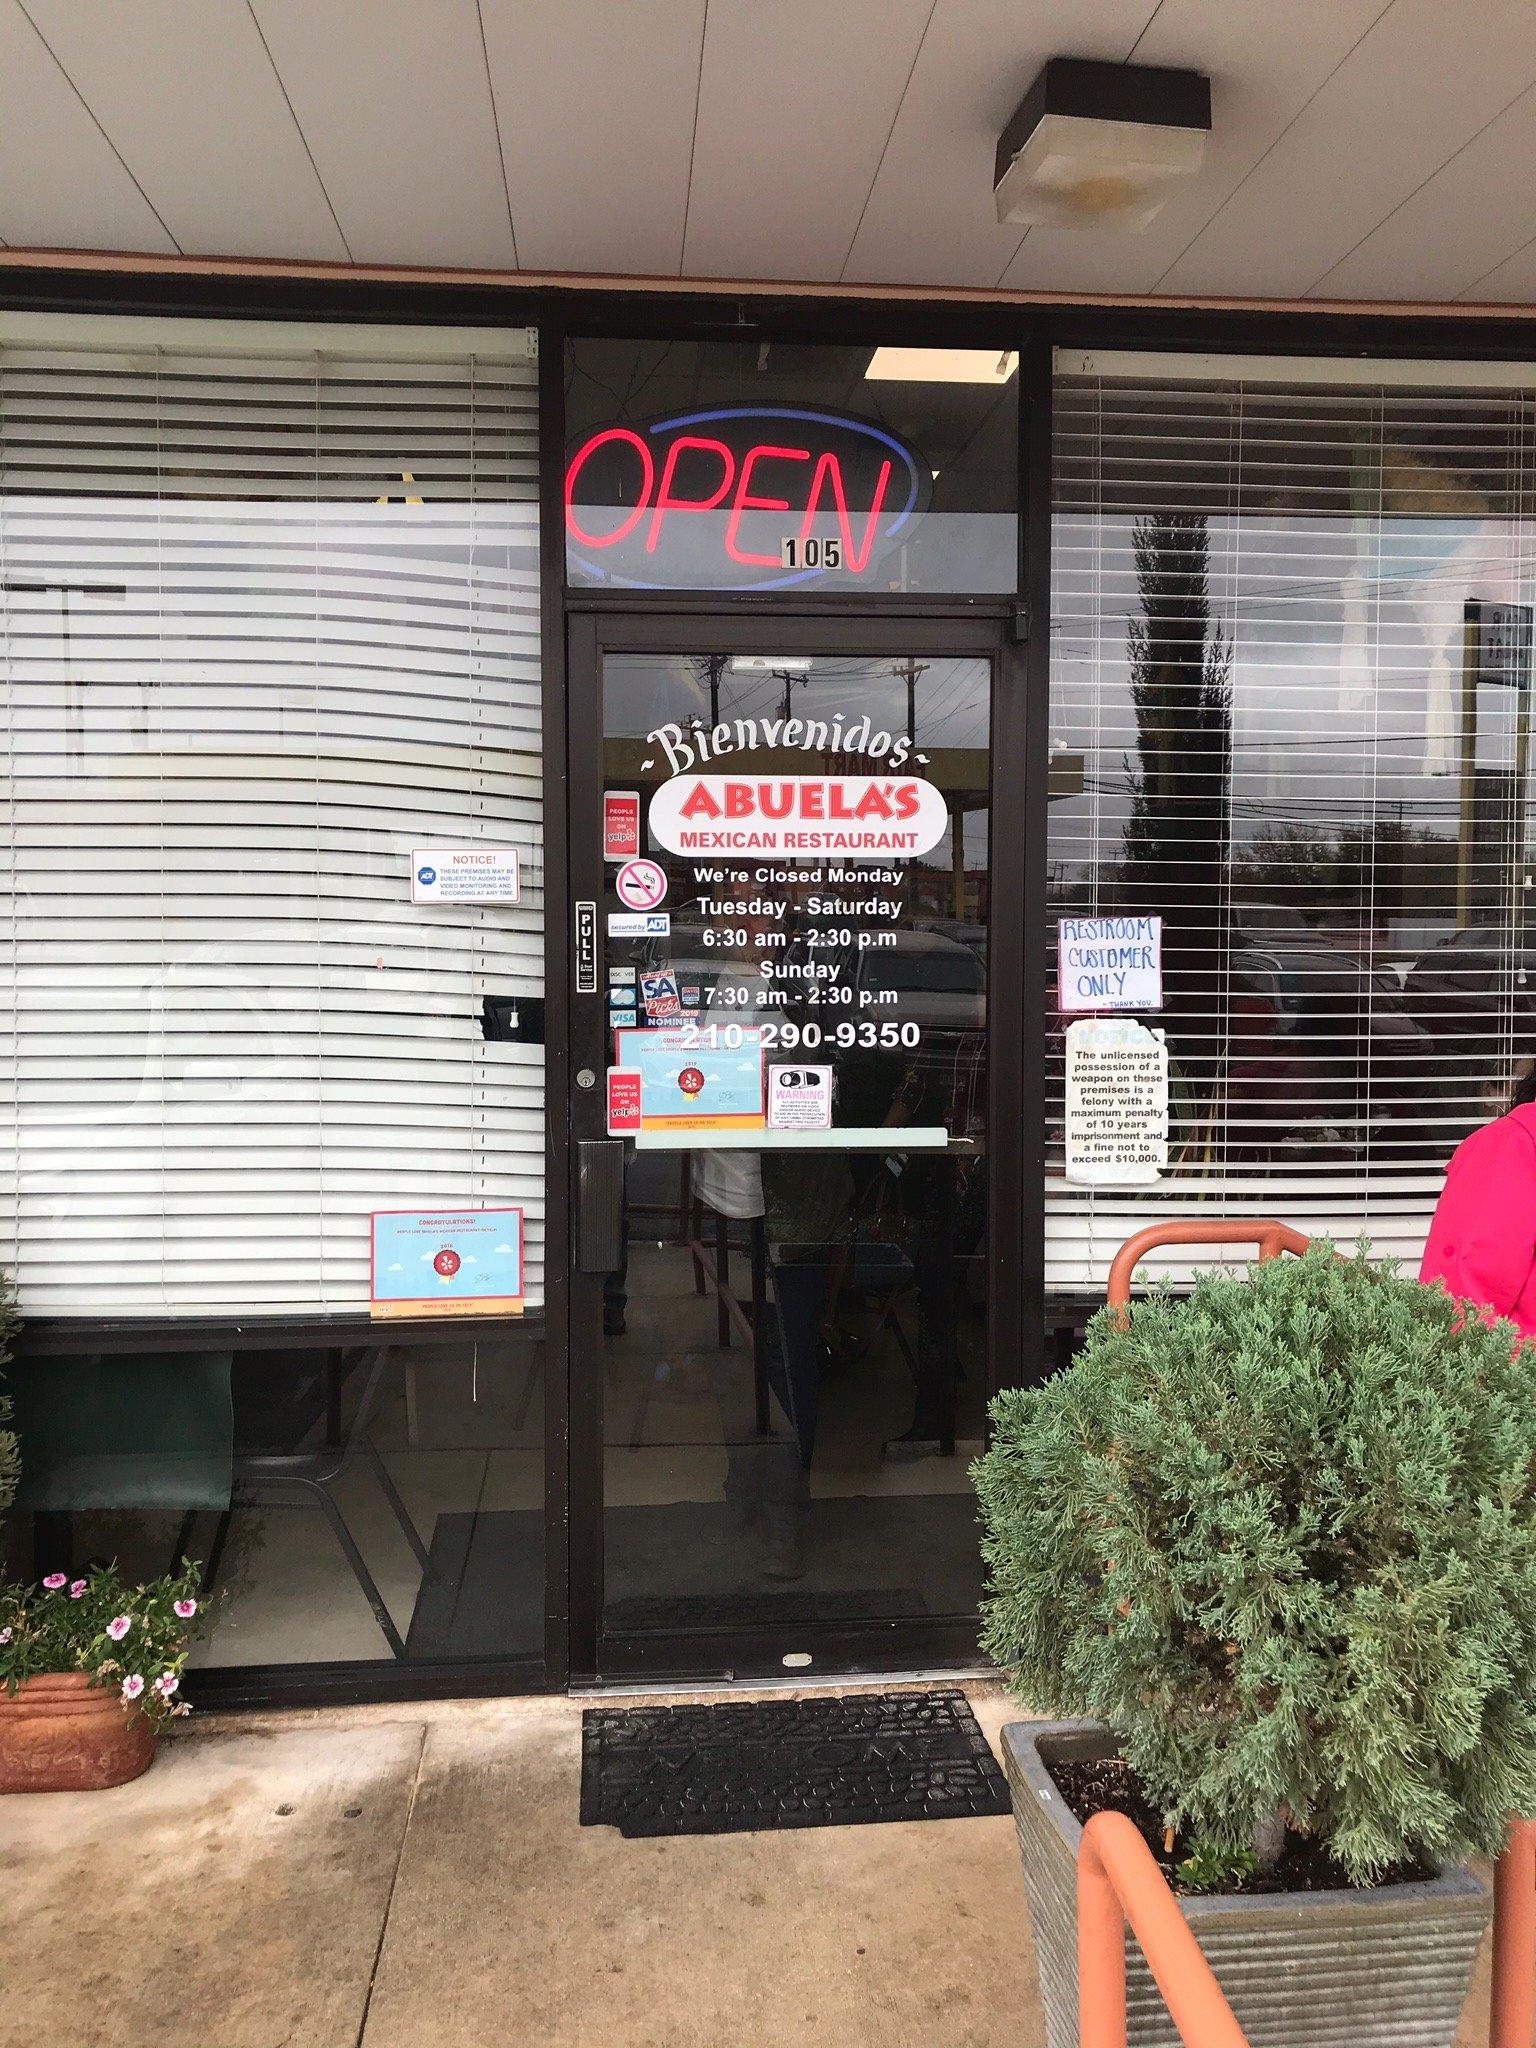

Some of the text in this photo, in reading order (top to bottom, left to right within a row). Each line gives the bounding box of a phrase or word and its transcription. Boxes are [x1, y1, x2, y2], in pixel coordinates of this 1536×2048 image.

[565, 428, 892, 573] OPEN
[784, 538, 840, 568] 105
[679, 781, 920, 821] ABUELA'S
[607, 832, 628, 842] yelp
[680, 832, 919, 849] MEXICAN RESTAURANT
[453, 855, 496, 864] NOTICE!
[420, 872, 434, 880] ADT
[755, 868, 822, 883] Closed
[828, 868, 904, 886] Monday
[697, 897, 787, 919] Tuesday
[807, 897, 903, 919] Saturday
[648, 918, 667, 931] ADT
[1063, 917, 1154, 941] RESTROOM
[581, 914, 592, 961] PULL
[702, 928, 748, 947] 6:30
[754, 932, 786, 947] am
[806, 928, 851, 947] 2:30
[858, 932, 897, 950] p.m
[1068, 946, 1156, 969] CUSTOMER
[759, 960, 840, 982] Sunday
[644, 977, 676, 998] SA
[1077, 971, 1126, 996] ONLY
[704, 987, 749, 1005] 7:30
[755, 990, 788, 1005] am
[807, 987, 852, 1005] 2:30
[859, 990, 898, 1008] p.m
[648, 999, 679, 1014] Picks
[648, 1018, 697, 1026] NOMINEE
[680, 1022, 921, 1049] 210-290-9350
[1076, 1051, 1160, 1060] The unlicensed
[1074, 1062, 1135, 1072] possession
[1139, 1062, 1150, 1070] of
[1072, 1076, 1114, 1084] weapon
[1133, 1074, 1163, 1082] these
[776, 1090, 824, 1100] WARNING
[1080, 1086, 1130, 1095] premises
[1134, 1086, 1144, 1094] is
[1082, 1097, 1114, 1107] felony
[1118, 1097, 1142, 1105] with
[612, 1108, 630, 1117] yelp
[1071, 1108, 1164, 1118] maximum penalty
[1086, 1120, 1148, 1130] of 10 years
[1072, 1132, 1162, 1141] imprisonment and
[1094, 1143, 1114, 1151] fine
[1072, 1154, 1160, 1164] exceed $10,000.
